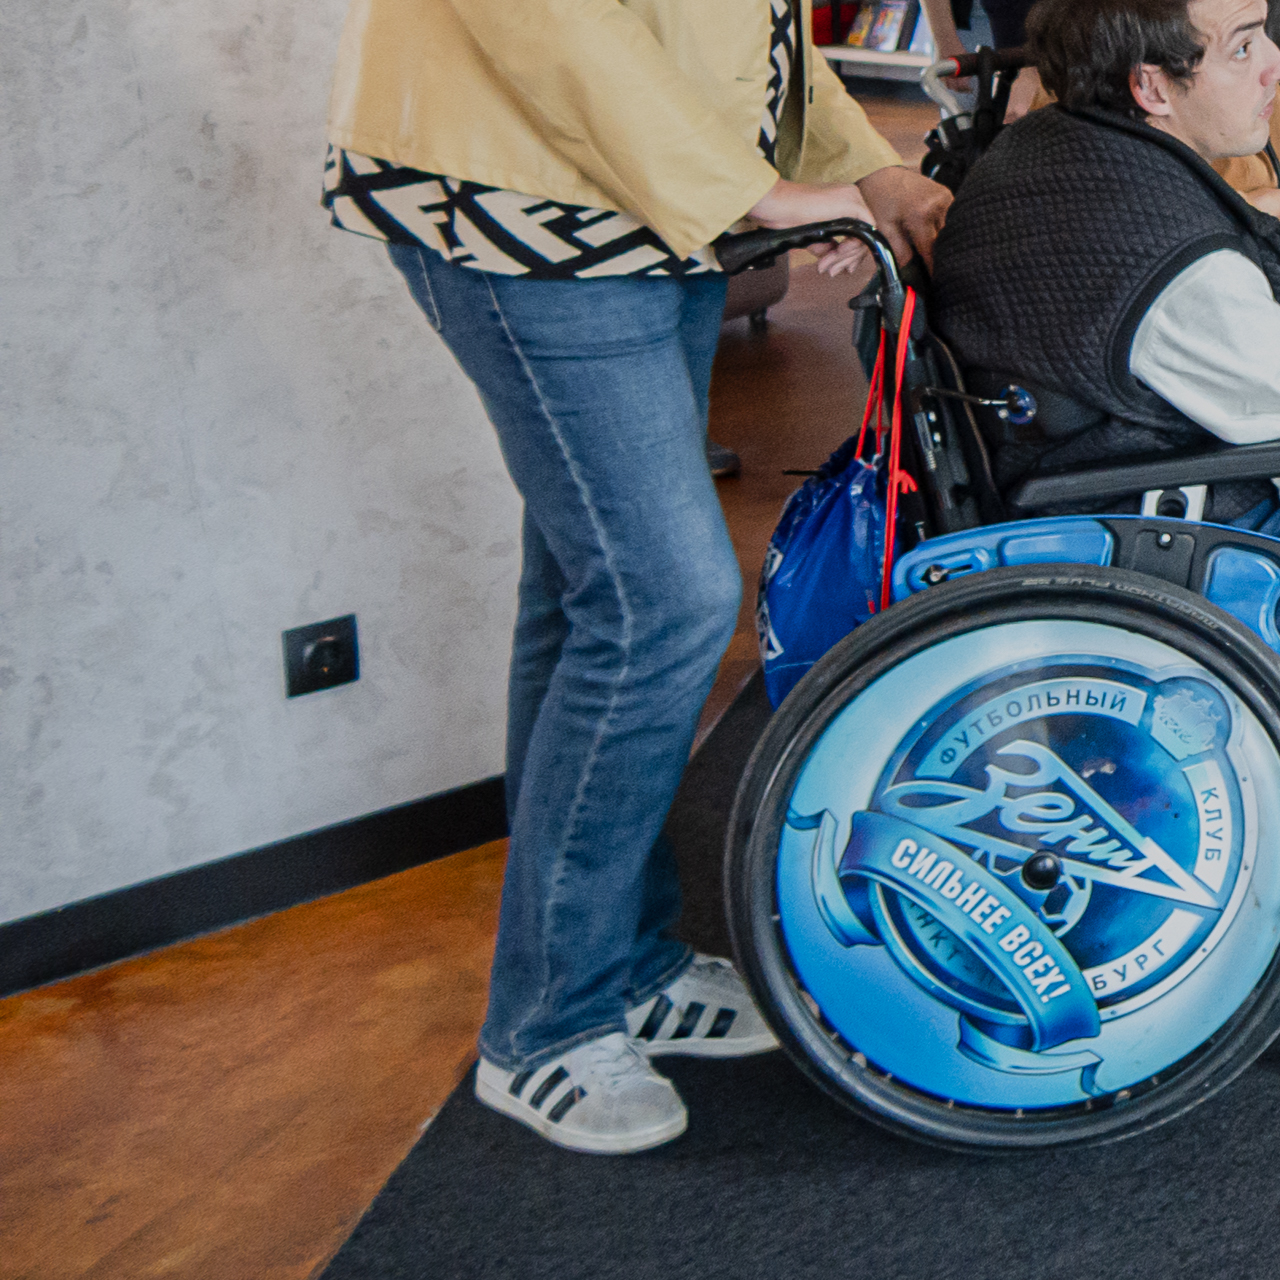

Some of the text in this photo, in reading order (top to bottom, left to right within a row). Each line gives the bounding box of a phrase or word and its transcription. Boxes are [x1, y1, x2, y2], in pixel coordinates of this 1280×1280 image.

[938, 689, 1128, 766] ФУТБОЛЬНЫЙ
[1200, 786, 1225, 863] КЛУБ
[890, 837, 1073, 1004] СИЛЬНЕЕ ВСЕХ!
